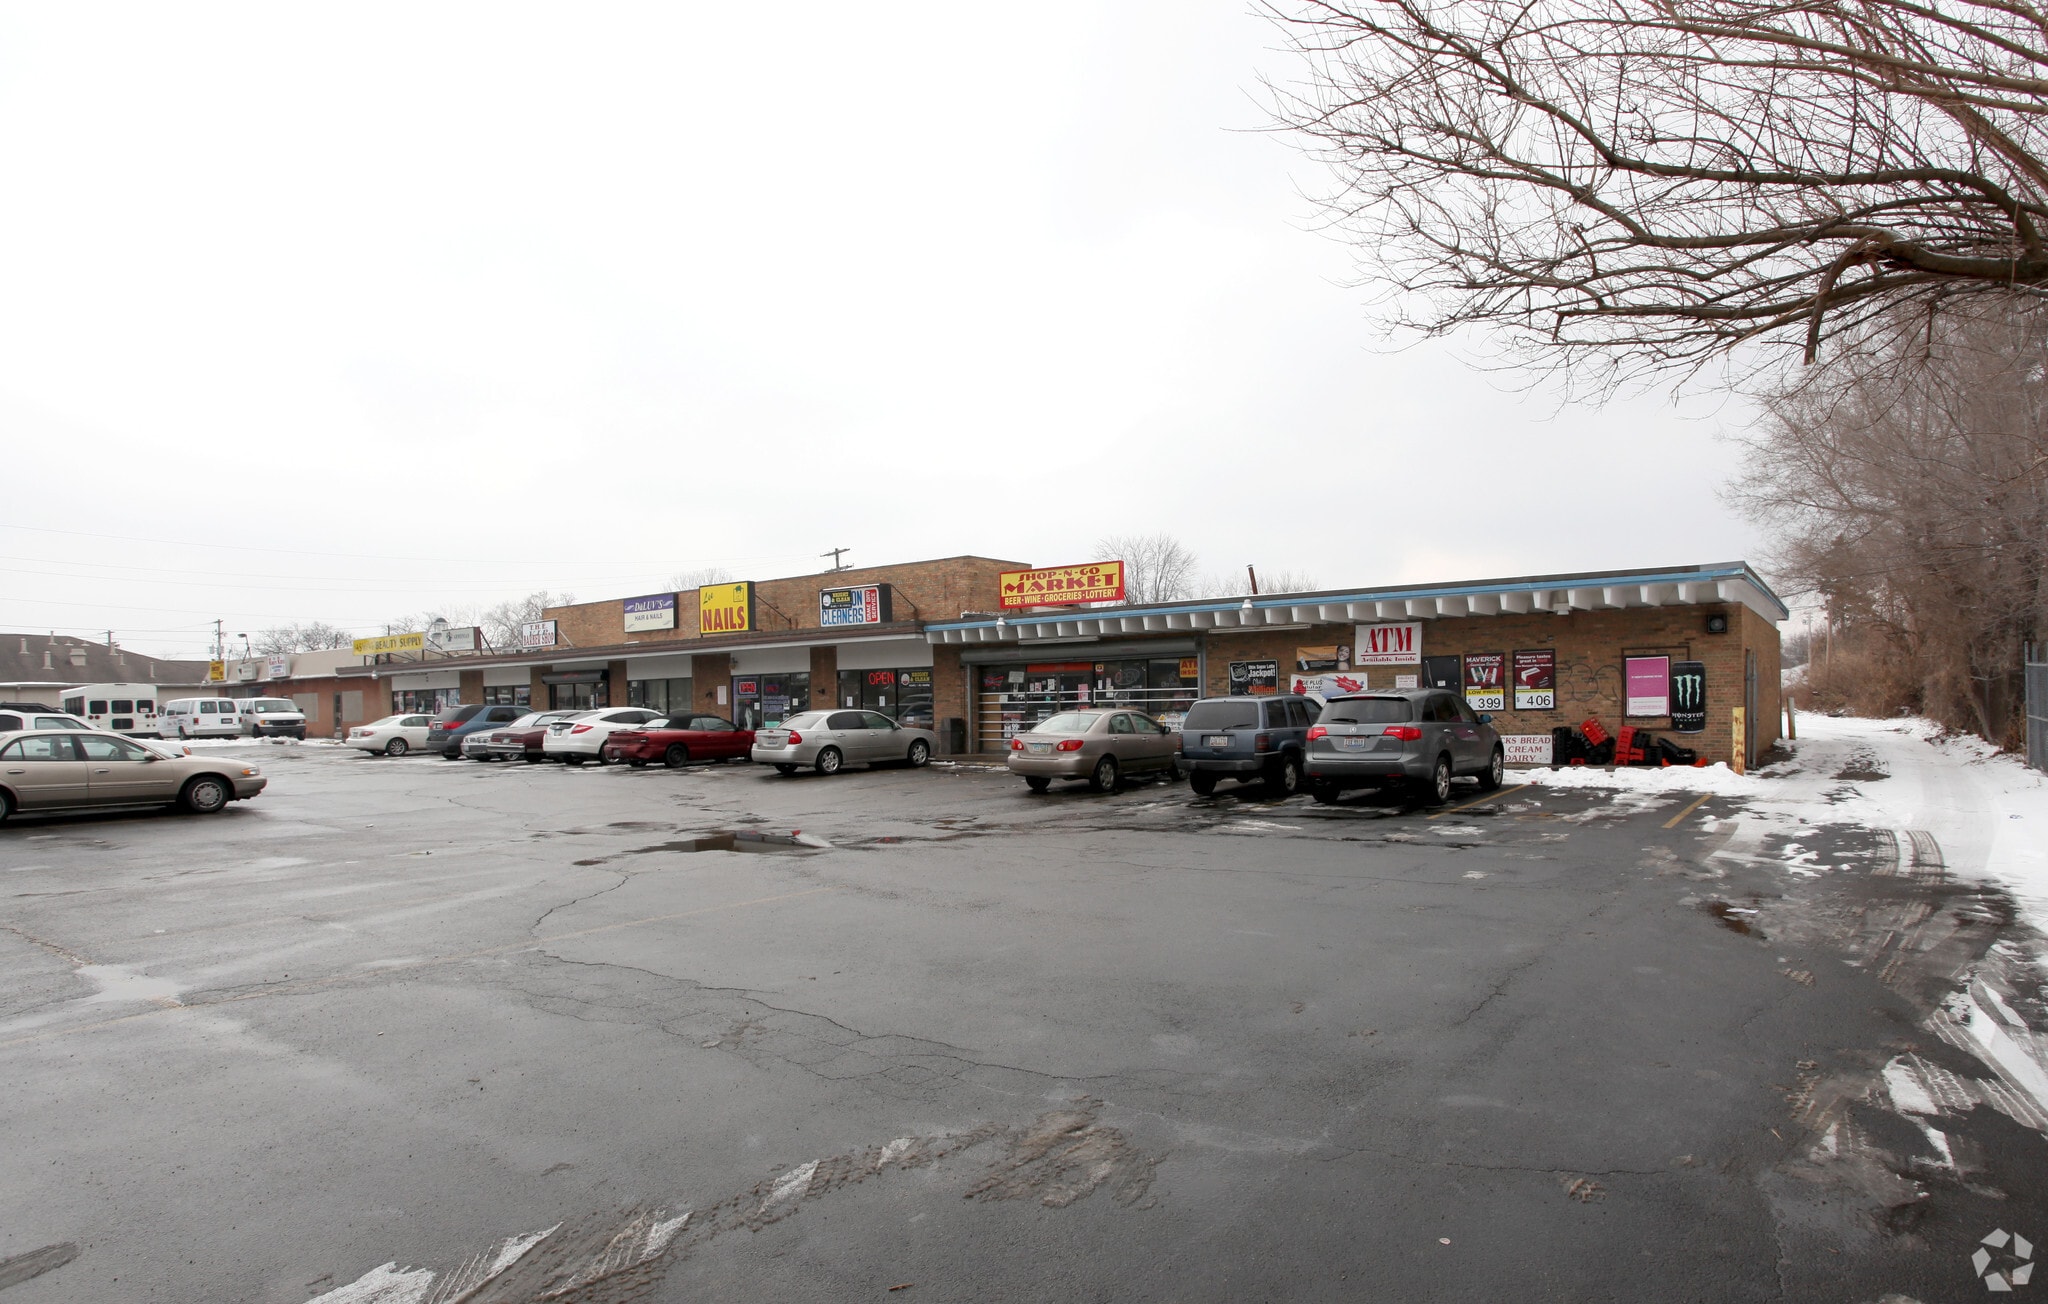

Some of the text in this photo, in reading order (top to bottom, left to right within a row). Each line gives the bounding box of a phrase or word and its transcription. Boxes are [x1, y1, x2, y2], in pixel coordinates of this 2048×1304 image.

[1004, 573, 1117, 595] MARKET
[1005, 588, 1117, 606] BEER WINE GROCERIES LOTTERY
[702, 606, 745, 631] NAILS
[822, 607, 864, 625] CLEANERS
[375, 638, 397, 650] BEAUTY
[400, 635, 422, 648] SUPPLY
[1365, 627, 1412, 653] ATM
[868, 671, 895, 685] OPEN
[1180, 669, 1198, 677] INSID
[1248, 669, 1276, 678] Jackpot!
[1671, 711, 1705, 719] MONSTER
[1505, 754, 1536, 762] DAIRY
